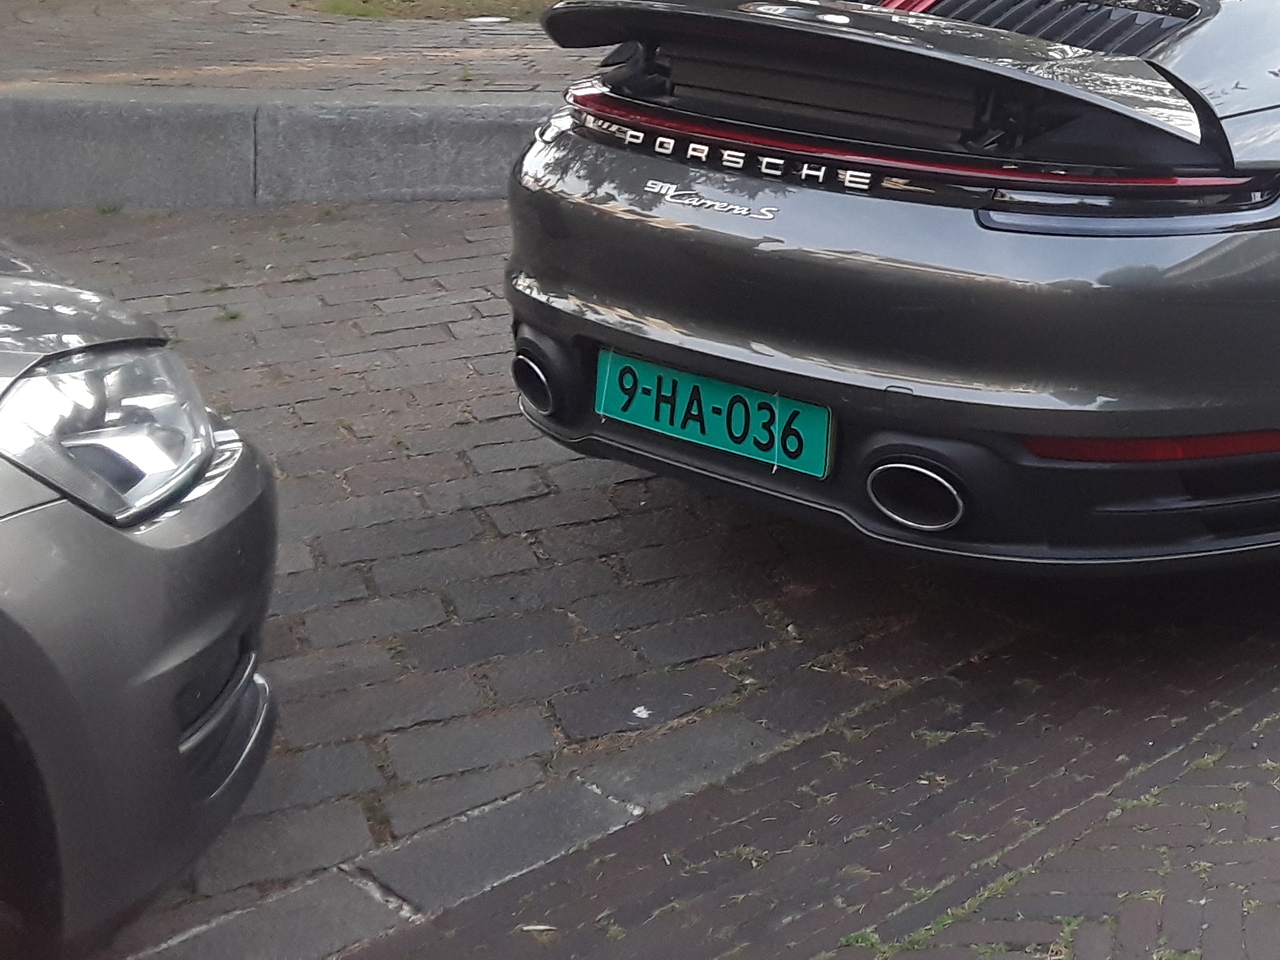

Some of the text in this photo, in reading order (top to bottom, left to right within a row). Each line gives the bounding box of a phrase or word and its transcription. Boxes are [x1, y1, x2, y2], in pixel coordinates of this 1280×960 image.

[624, 129, 873, 190] PORSCHE
[664, 190, 751, 216] Carrera
[749, 206, 780, 221] S
[617, 365, 805, 460] 9-HA-036
